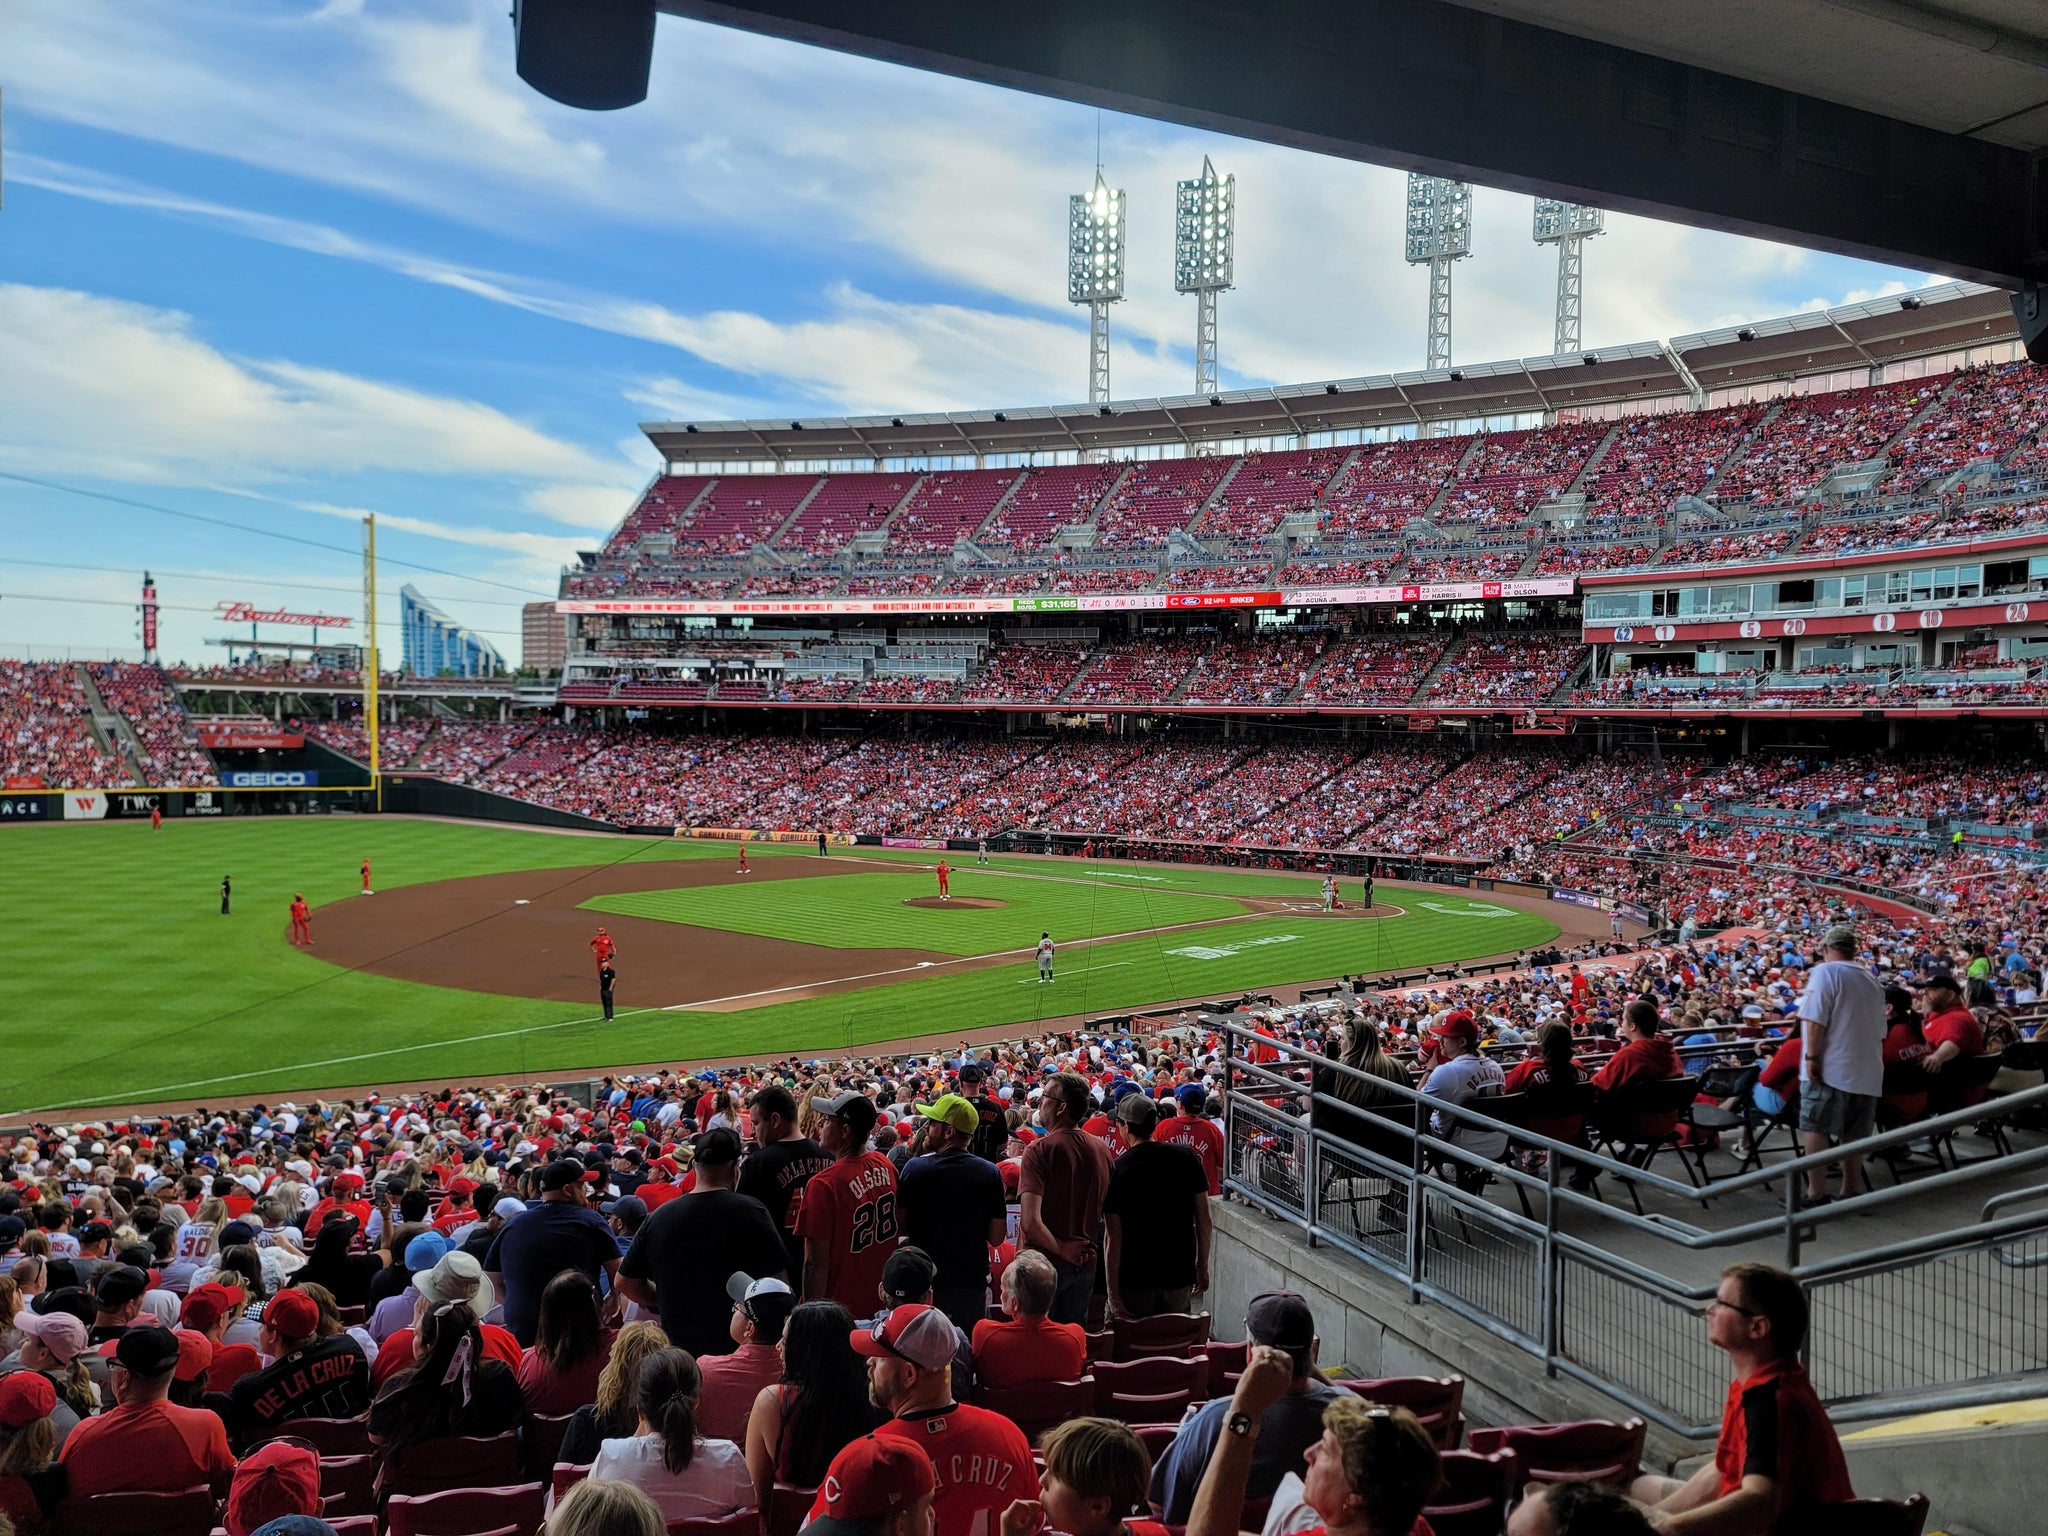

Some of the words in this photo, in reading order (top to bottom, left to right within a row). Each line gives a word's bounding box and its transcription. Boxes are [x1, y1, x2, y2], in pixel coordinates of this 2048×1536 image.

[1041, 600, 1077, 609] $31,165
[1229, 596, 1255, 604] SINKER
[218, 601, 353, 628] Budweiser
[2009, 603, 2026, 622] 24
[1746, 622, 1755, 637] 5
[1786, 620, 1804, 635] 20
[1880, 614, 1888, 630] 8
[1615, 627, 1631, 641] 42
[1660, 626, 1668, 640] 1
[232, 772, 306, 786] GEICO
[118, 795, 160, 811] TWC
[1650, 817, 1675, 826] SCOUTS
[699, 830, 725, 840] GORILLA
[726, 832, 744, 841] GLUE
[780, 833, 808, 842] GORILLA
[1533, 1069, 1551, 1084] DE
[777, 1165, 794, 1188] DE
[790, 1159, 806, 1179] LA
[67, 1182, 89, 1191] OLSON
[849, 1167, 891, 1199] OLSON
[850, 1191, 899, 1253] 28
[180, 1237, 212, 1257] 30
[253, 1387, 286, 1419] DE
[281, 1369, 311, 1399] LA
[311, 1354, 355, 1385] CRUZ
[951, 1454, 1013, 1491] CRUZ
[825, 1475, 842, 1503] C
